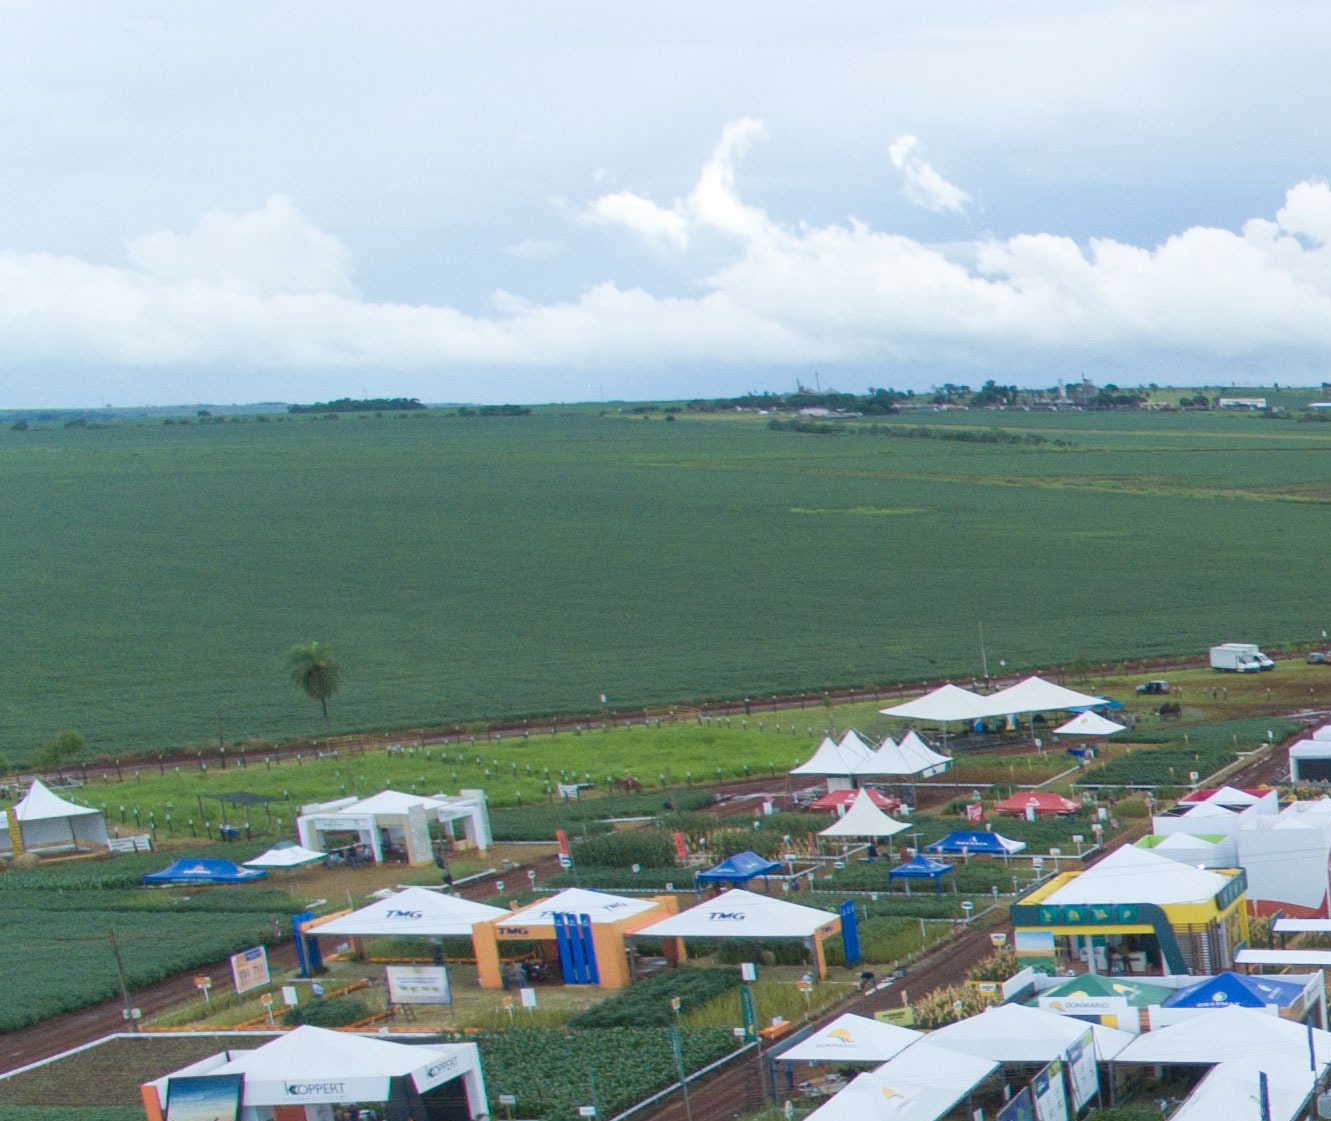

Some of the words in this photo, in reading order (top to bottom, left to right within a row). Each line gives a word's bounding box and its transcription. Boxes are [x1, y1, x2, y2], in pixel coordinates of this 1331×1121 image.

[386, 910, 423, 918] TMG
[708, 912, 746, 920] TMG
[498, 927, 528, 935] TMG
[284, 1081, 345, 1095] KOPPERT
